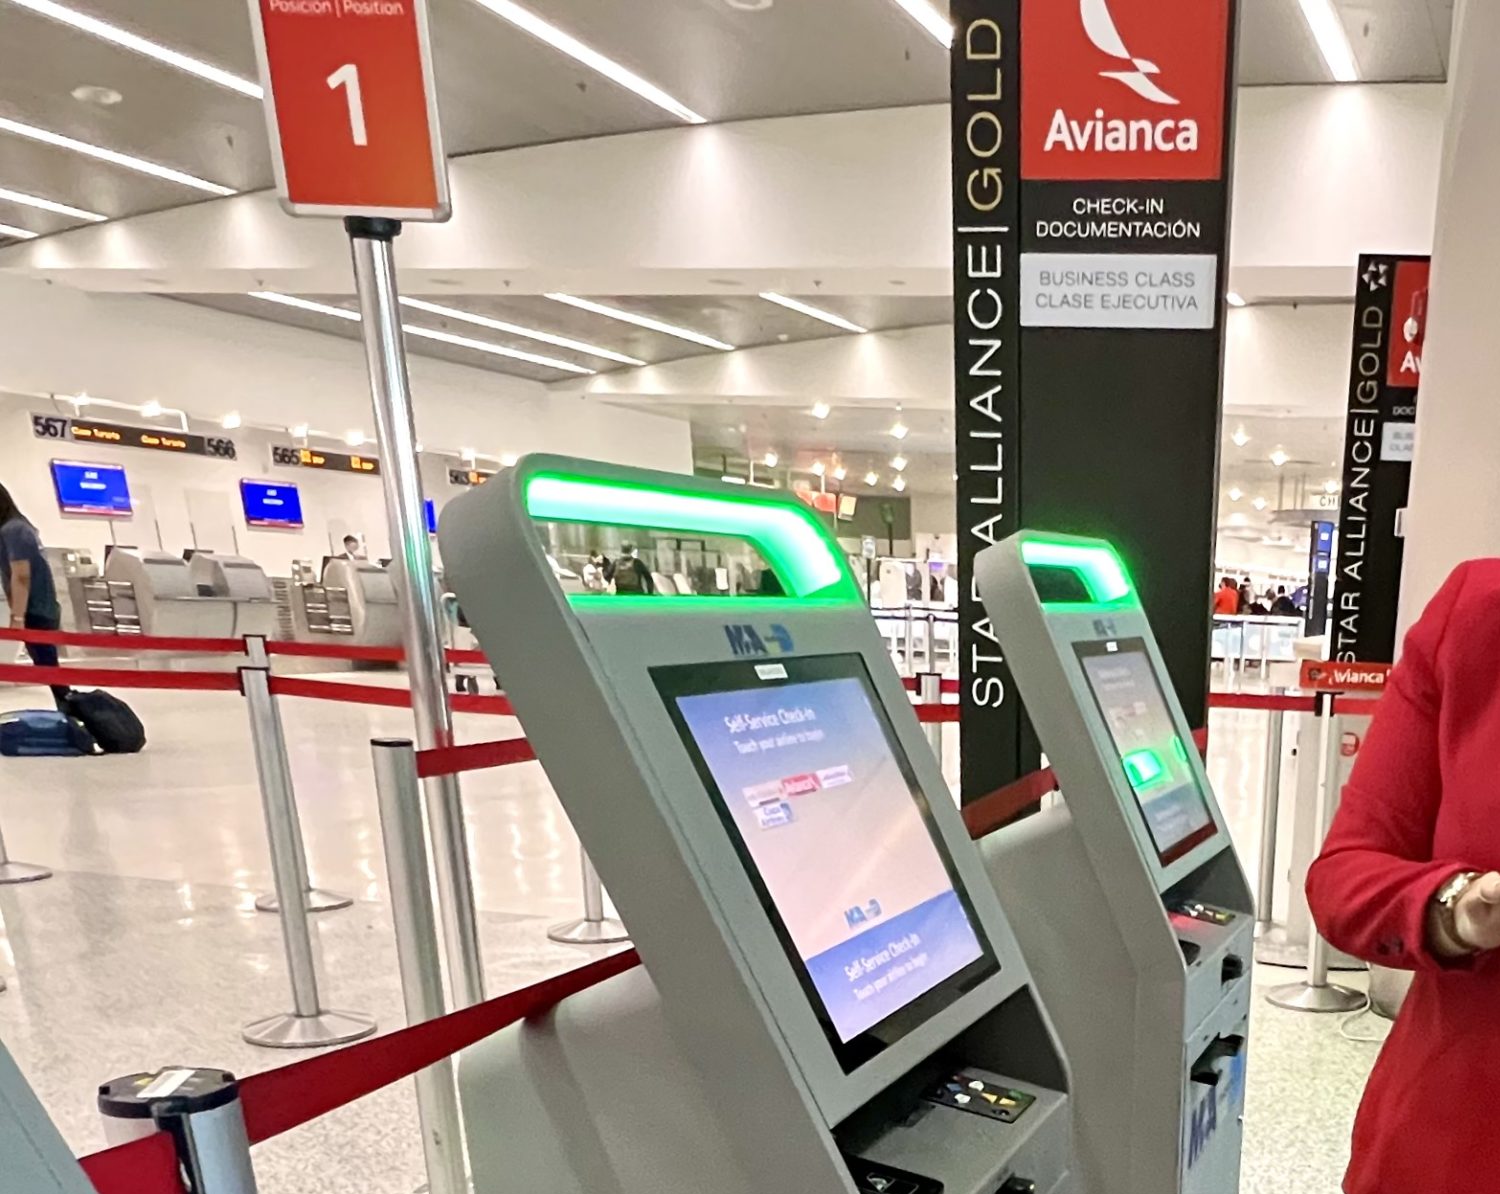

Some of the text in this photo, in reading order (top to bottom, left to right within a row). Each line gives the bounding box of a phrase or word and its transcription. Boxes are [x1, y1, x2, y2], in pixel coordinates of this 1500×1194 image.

[326, 63, 368, 147] 1
[966, 18, 1003, 212] GOLD
[1044, 108, 1200, 152] Avianca
[1072, 197, 1165, 216] CHECK-IN
[1035, 219, 1201, 239] DOCUMENTACIÓN
[1034, 293, 1199, 311] CLASE EJECUTIVA
[1039, 271, 1196, 289] BUSINESS CLASS
[1356, 306, 1383, 404] GOLD
[967, 244, 1003, 548] ALLIANCE
[33, 415, 68, 439] 567
[1343, 418, 1374, 581] ALLIANCE
